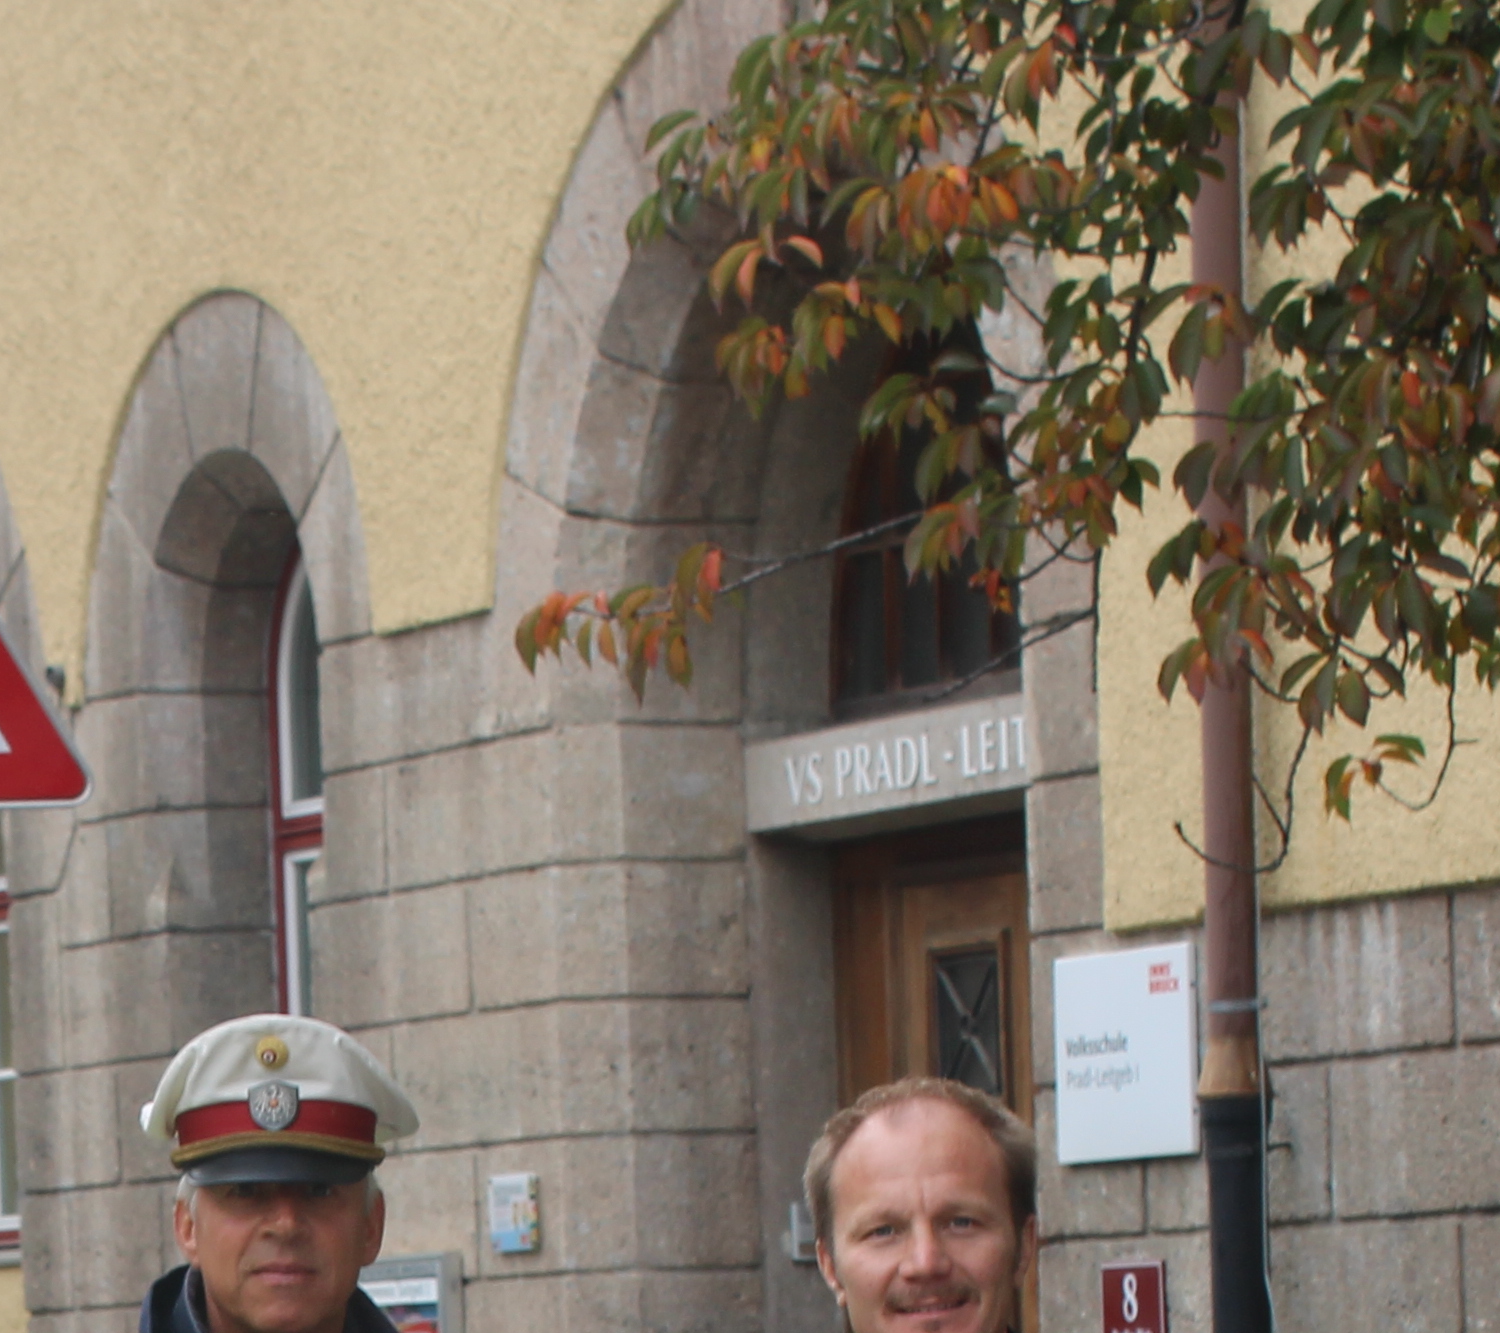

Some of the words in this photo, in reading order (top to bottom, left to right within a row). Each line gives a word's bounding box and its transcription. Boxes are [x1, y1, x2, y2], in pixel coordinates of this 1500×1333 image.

[785, 751, 823, 805] VS
[834, 733, 939, 799] PRADL
[1065, 1030, 1128, 1058] Volksschule
[1122, 1272, 1139, 1323] 8
